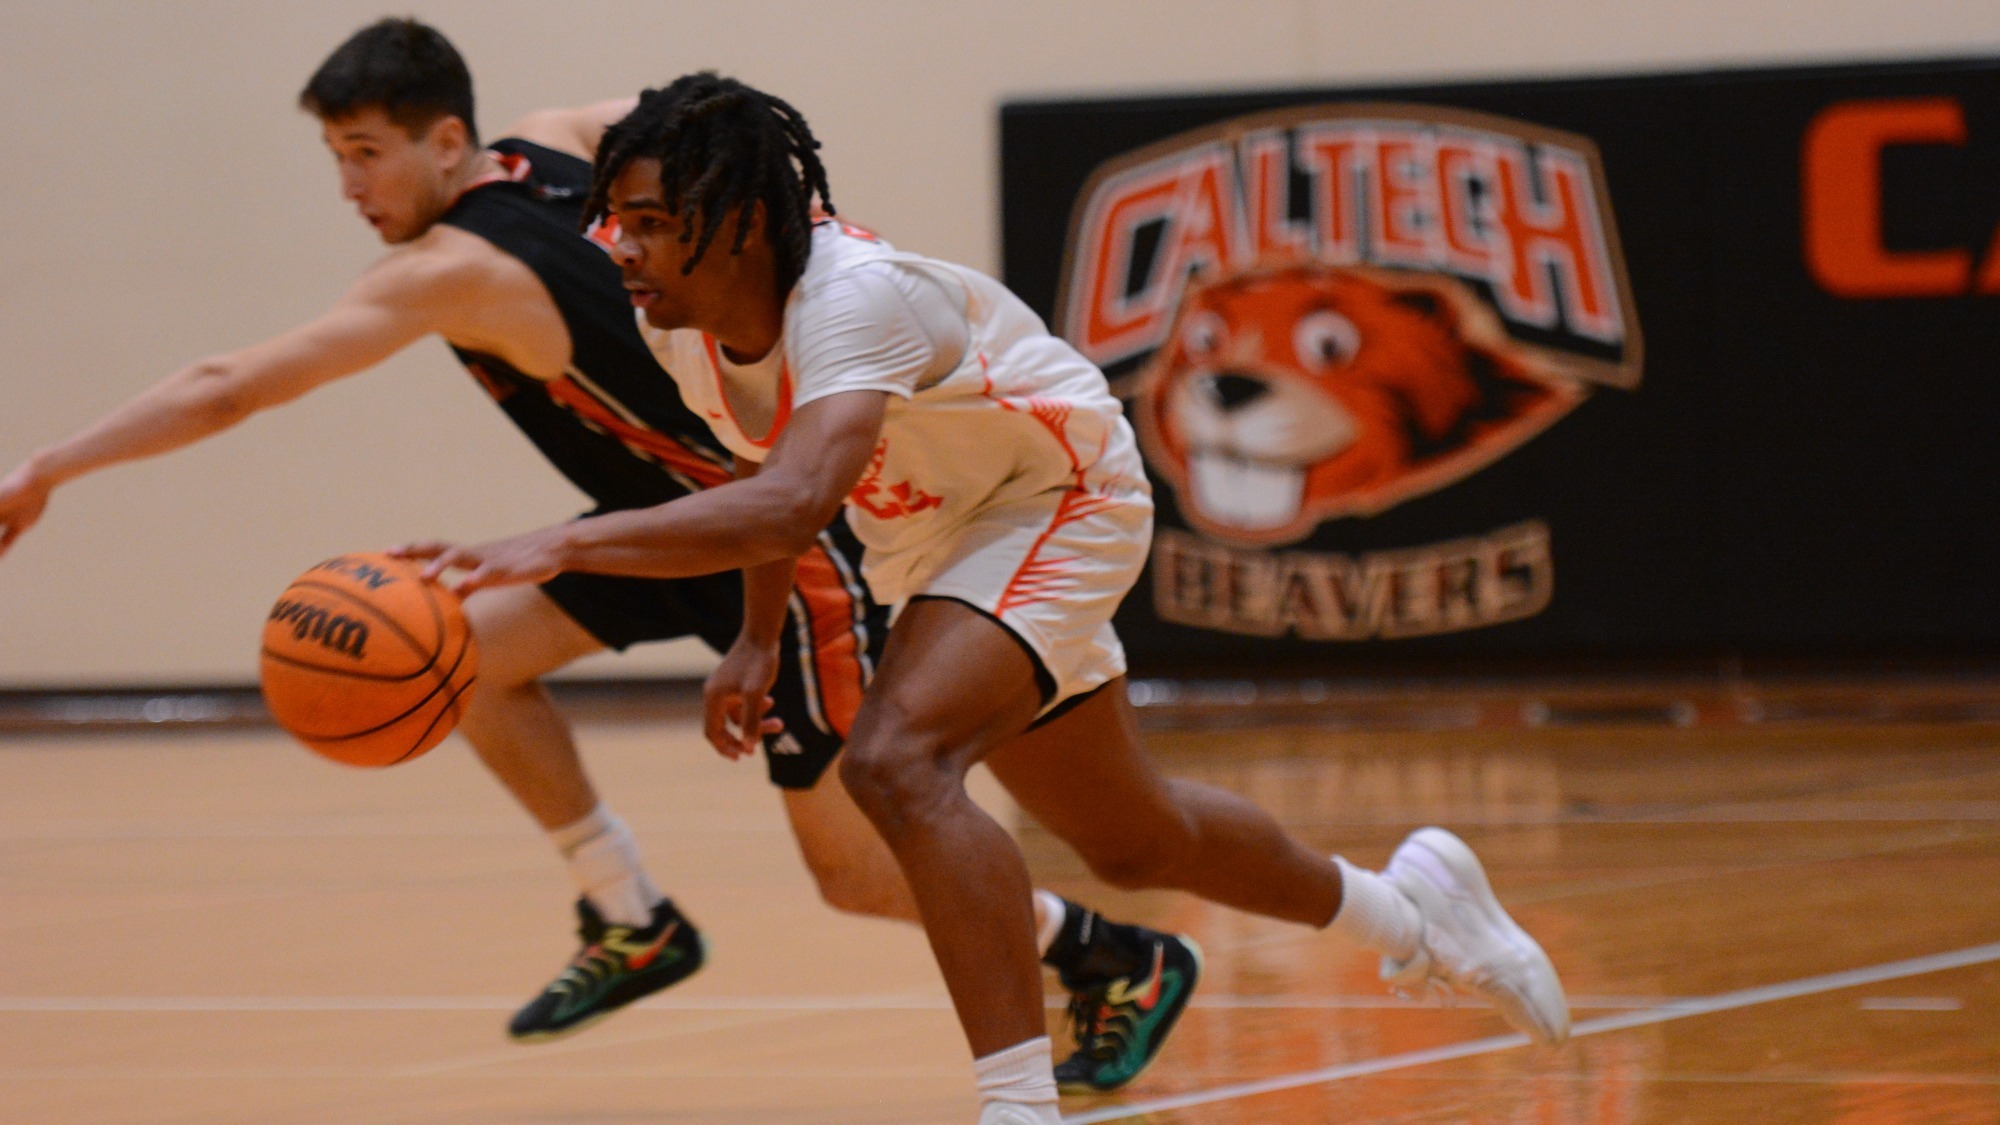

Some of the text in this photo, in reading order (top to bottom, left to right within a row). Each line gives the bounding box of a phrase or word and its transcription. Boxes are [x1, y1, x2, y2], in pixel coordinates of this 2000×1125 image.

[1066, 118, 1624, 364] CALTECH
[1801, 97, 2000, 298] C
[268, 600, 369, 661] Wil
[1154, 522, 1552, 638] BEAVERS
